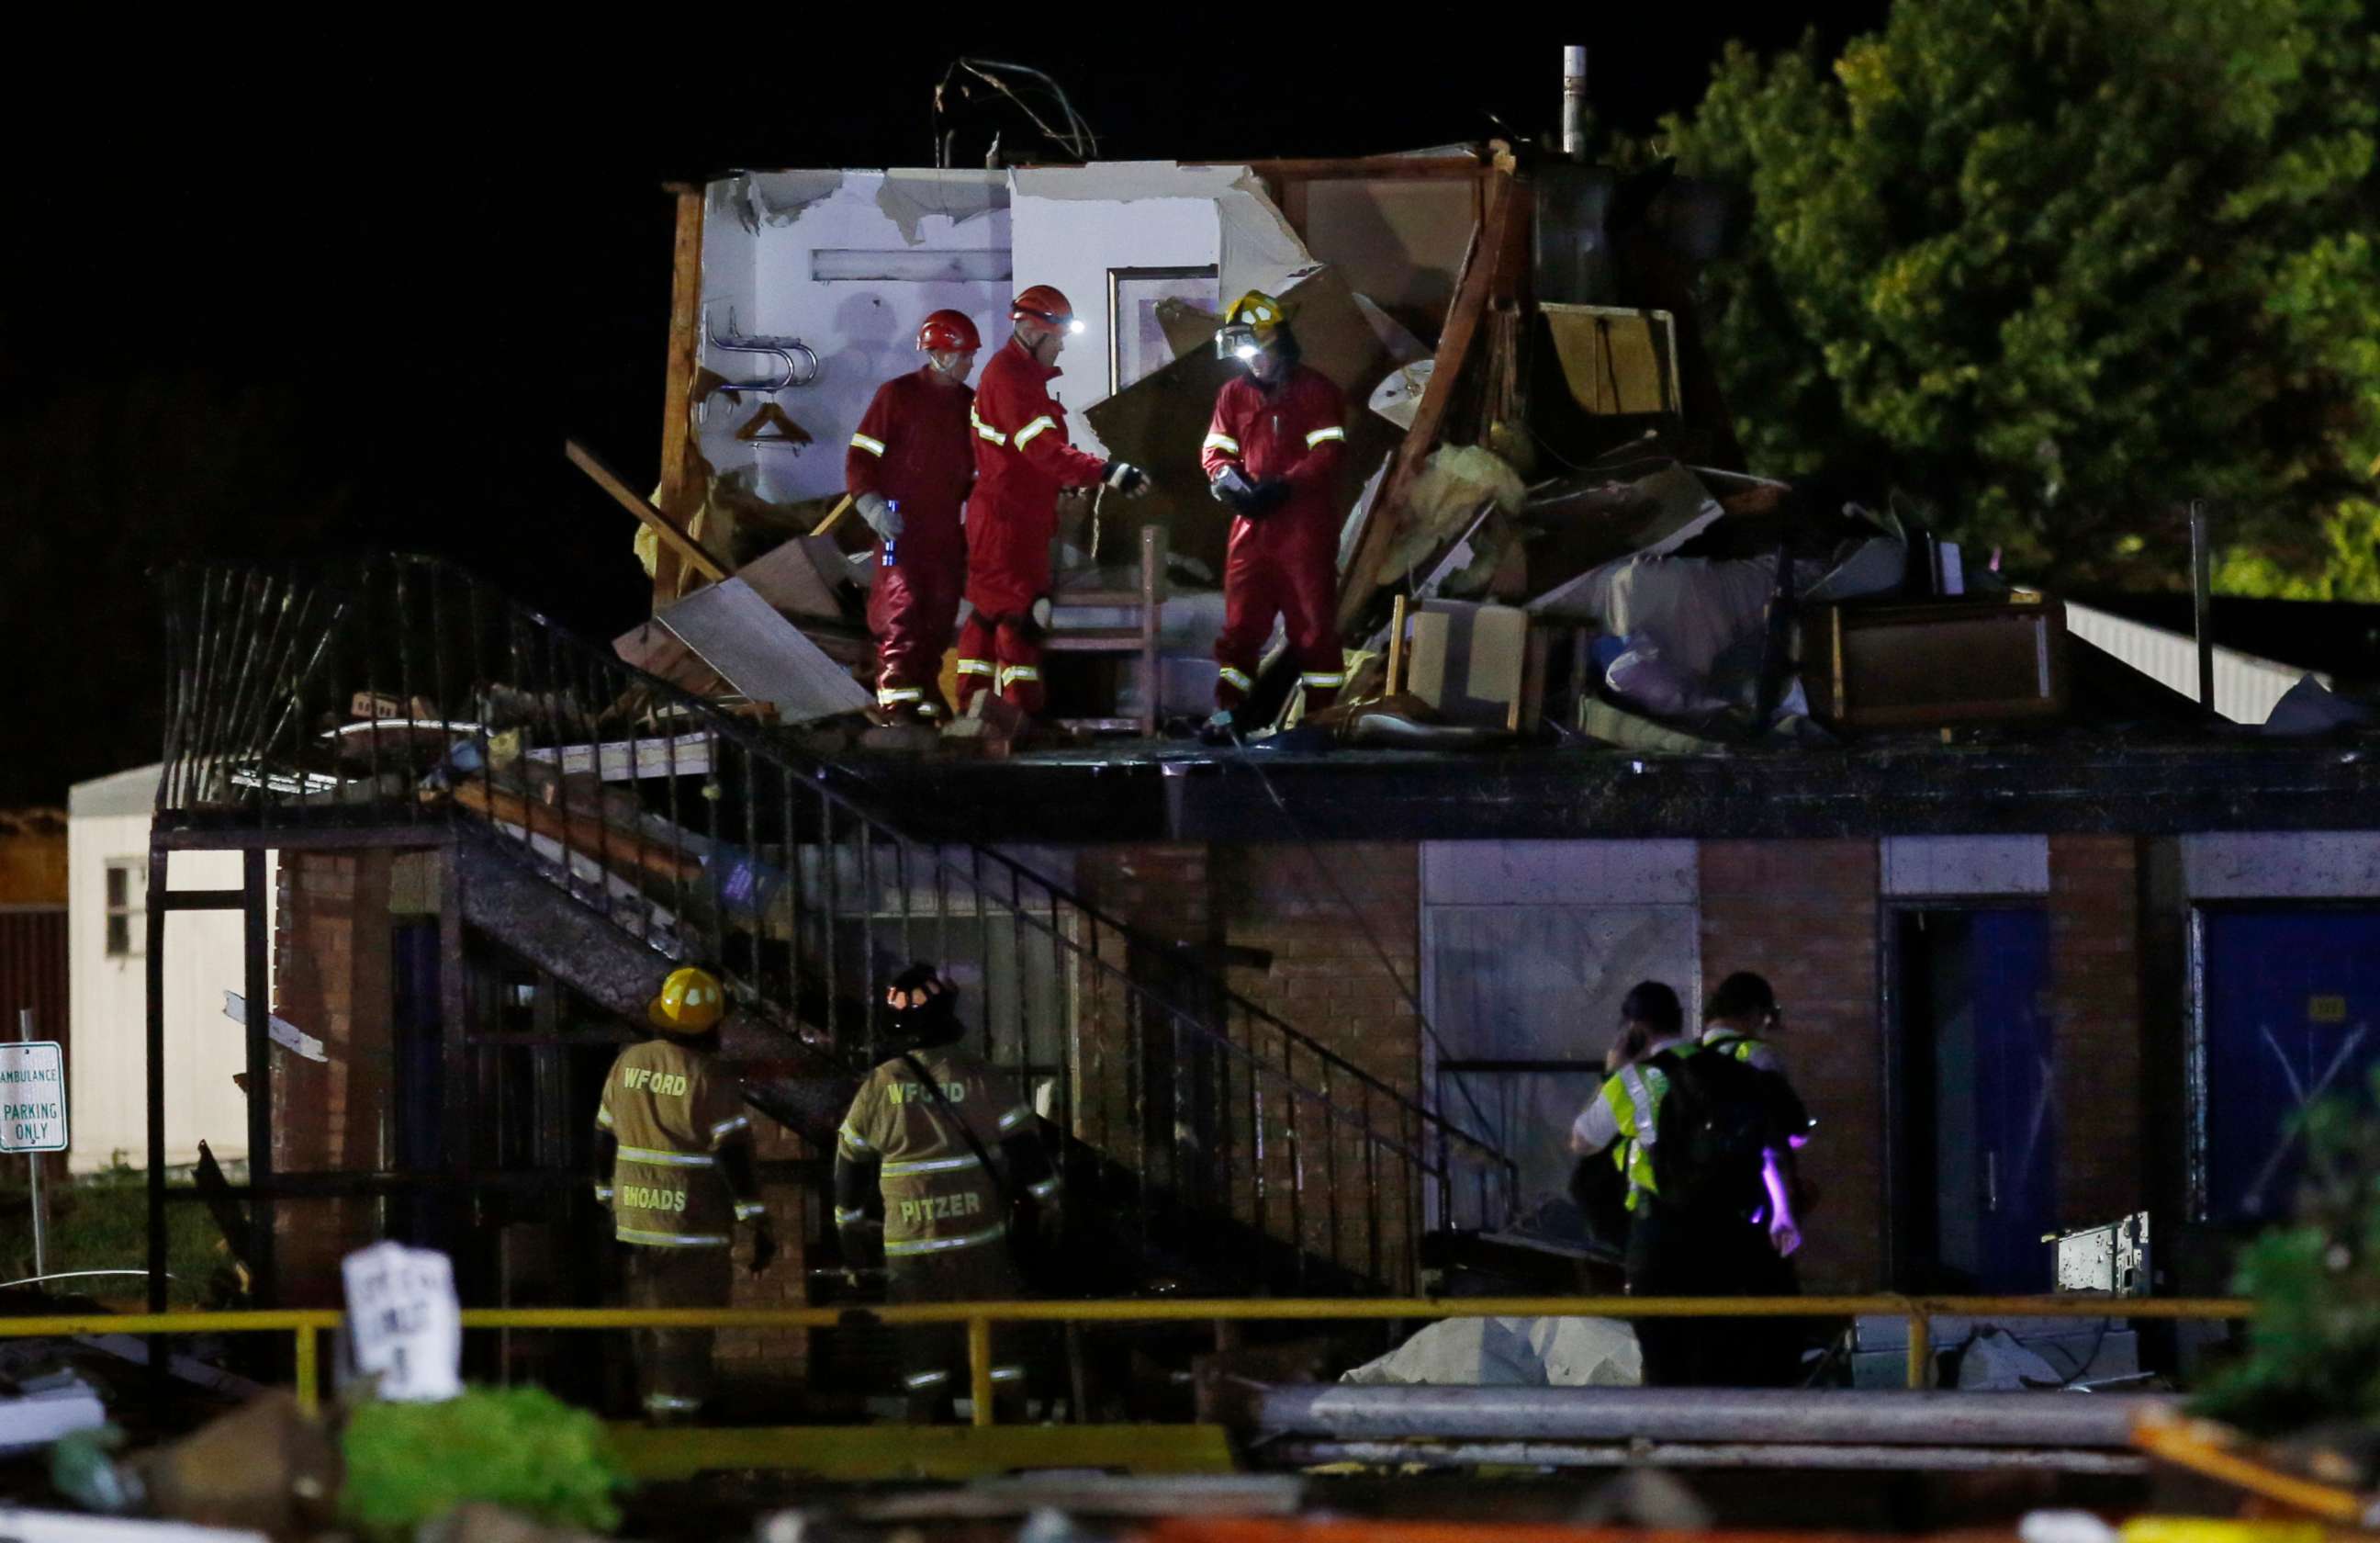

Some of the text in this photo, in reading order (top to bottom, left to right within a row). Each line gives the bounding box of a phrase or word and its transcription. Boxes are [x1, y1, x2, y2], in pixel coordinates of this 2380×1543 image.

[0, 1069, 57, 1084] AMBULANCE
[624, 1067, 687, 1096] WFORD
[4, 1103, 57, 1121] PARKING
[16, 1122, 48, 1140] ONLY
[900, 1191, 981, 1222] PITZER
